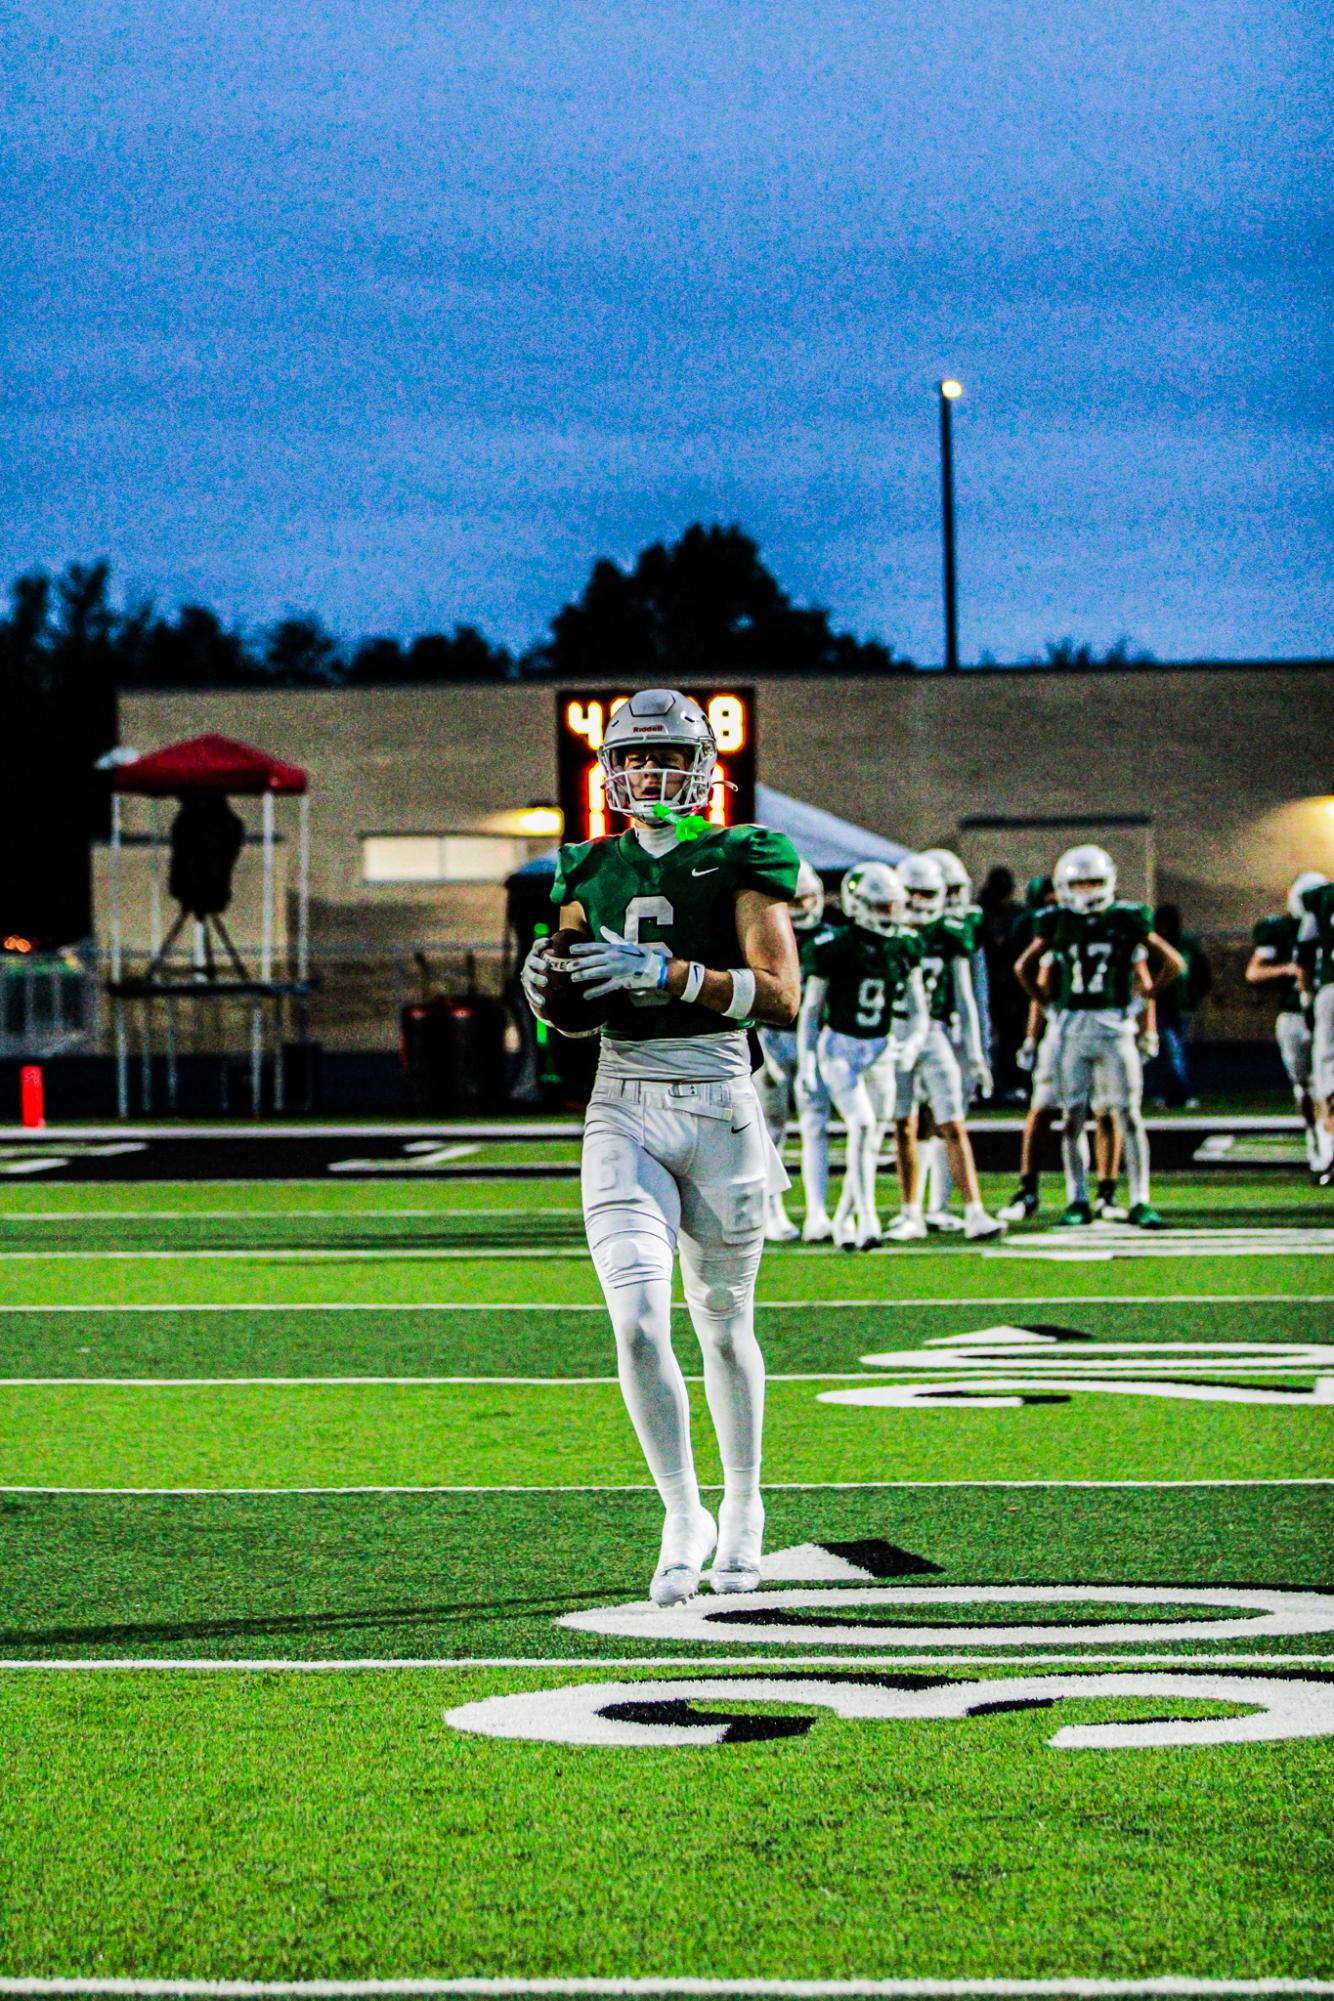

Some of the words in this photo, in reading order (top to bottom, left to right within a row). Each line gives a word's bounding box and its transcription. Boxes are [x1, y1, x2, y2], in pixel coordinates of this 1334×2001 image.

[632, 724, 664, 734] Riddell
[624, 896, 675, 1008] 6
[1068, 943, 1113, 994] 17
[857, 979, 886, 1026] 9
